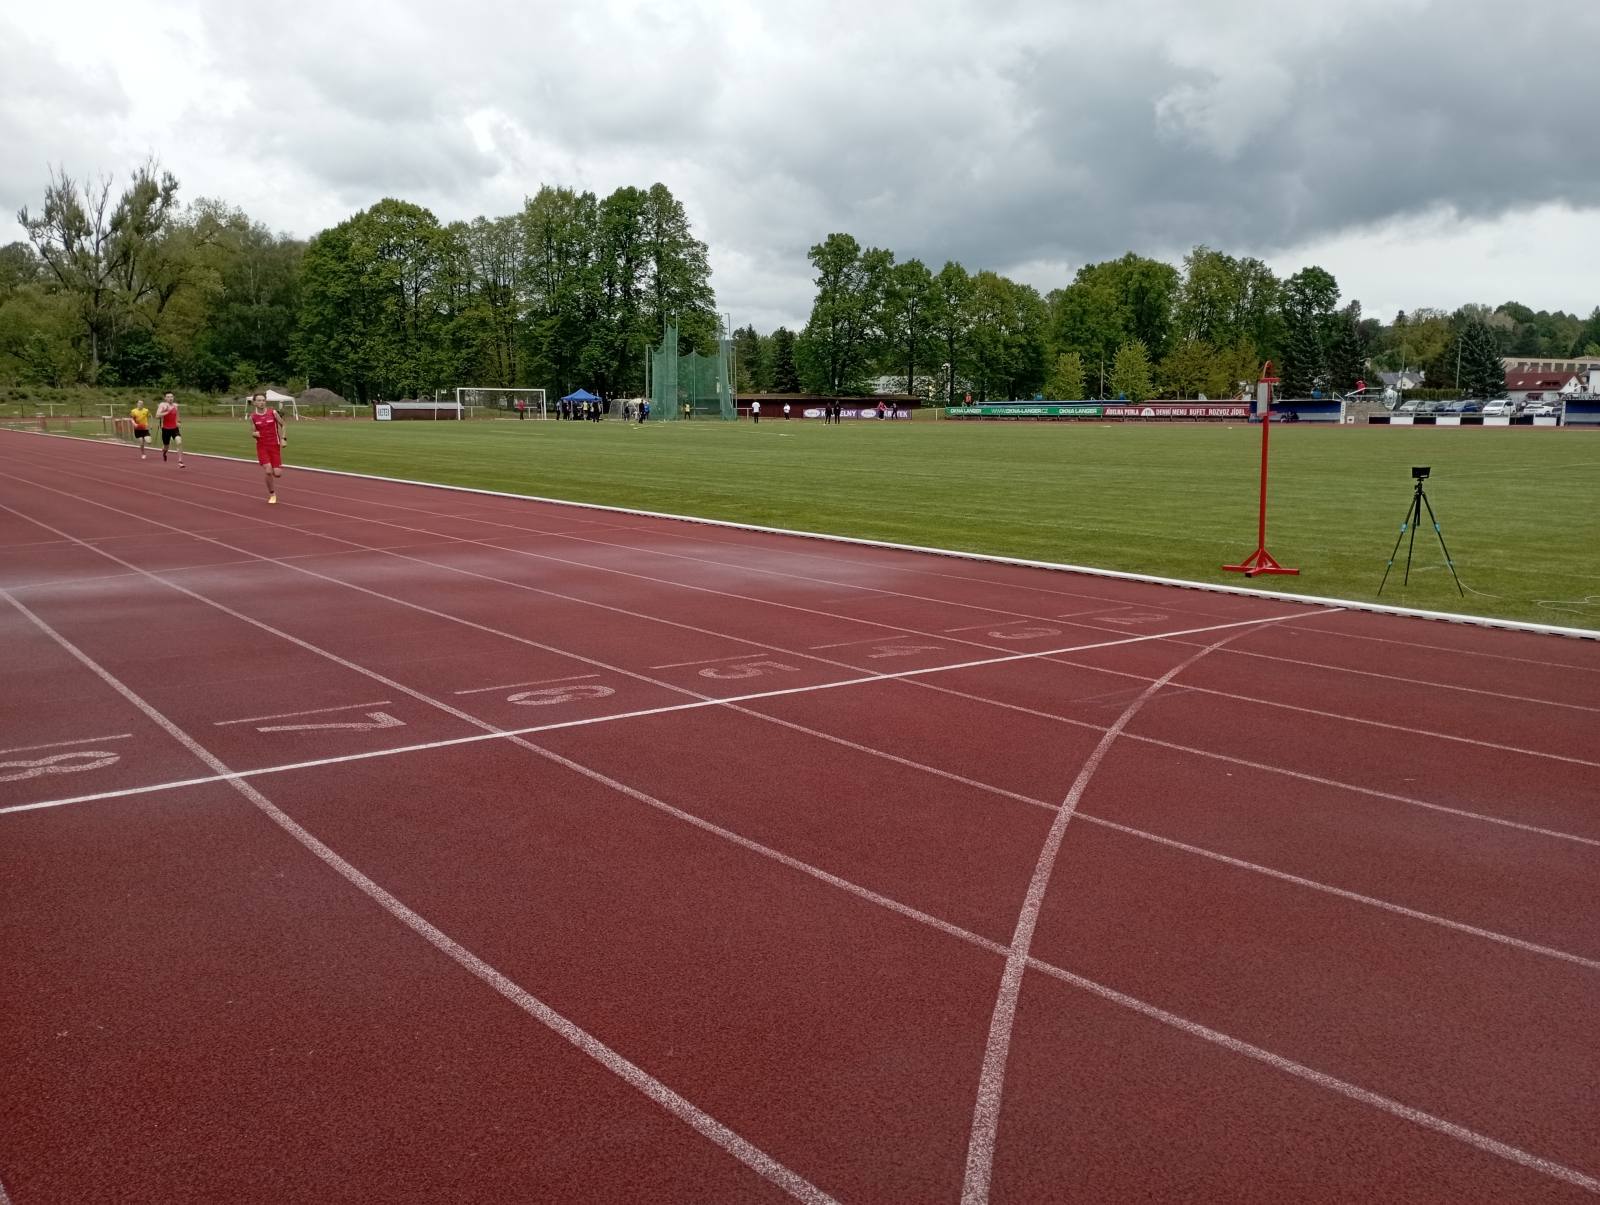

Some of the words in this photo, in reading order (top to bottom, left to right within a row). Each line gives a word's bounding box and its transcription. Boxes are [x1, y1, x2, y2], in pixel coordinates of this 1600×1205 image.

[1172, 408, 1187, 416] MENU
[1208, 408, 1229, 416] ROZVOZ
[1230, 407, 1245, 416] JÍDEL
[988, 627, 1062, 640] 3
[698, 661, 801, 680] 5
[507, 685, 616, 706] 6
[256, 711, 406, 732] 7
